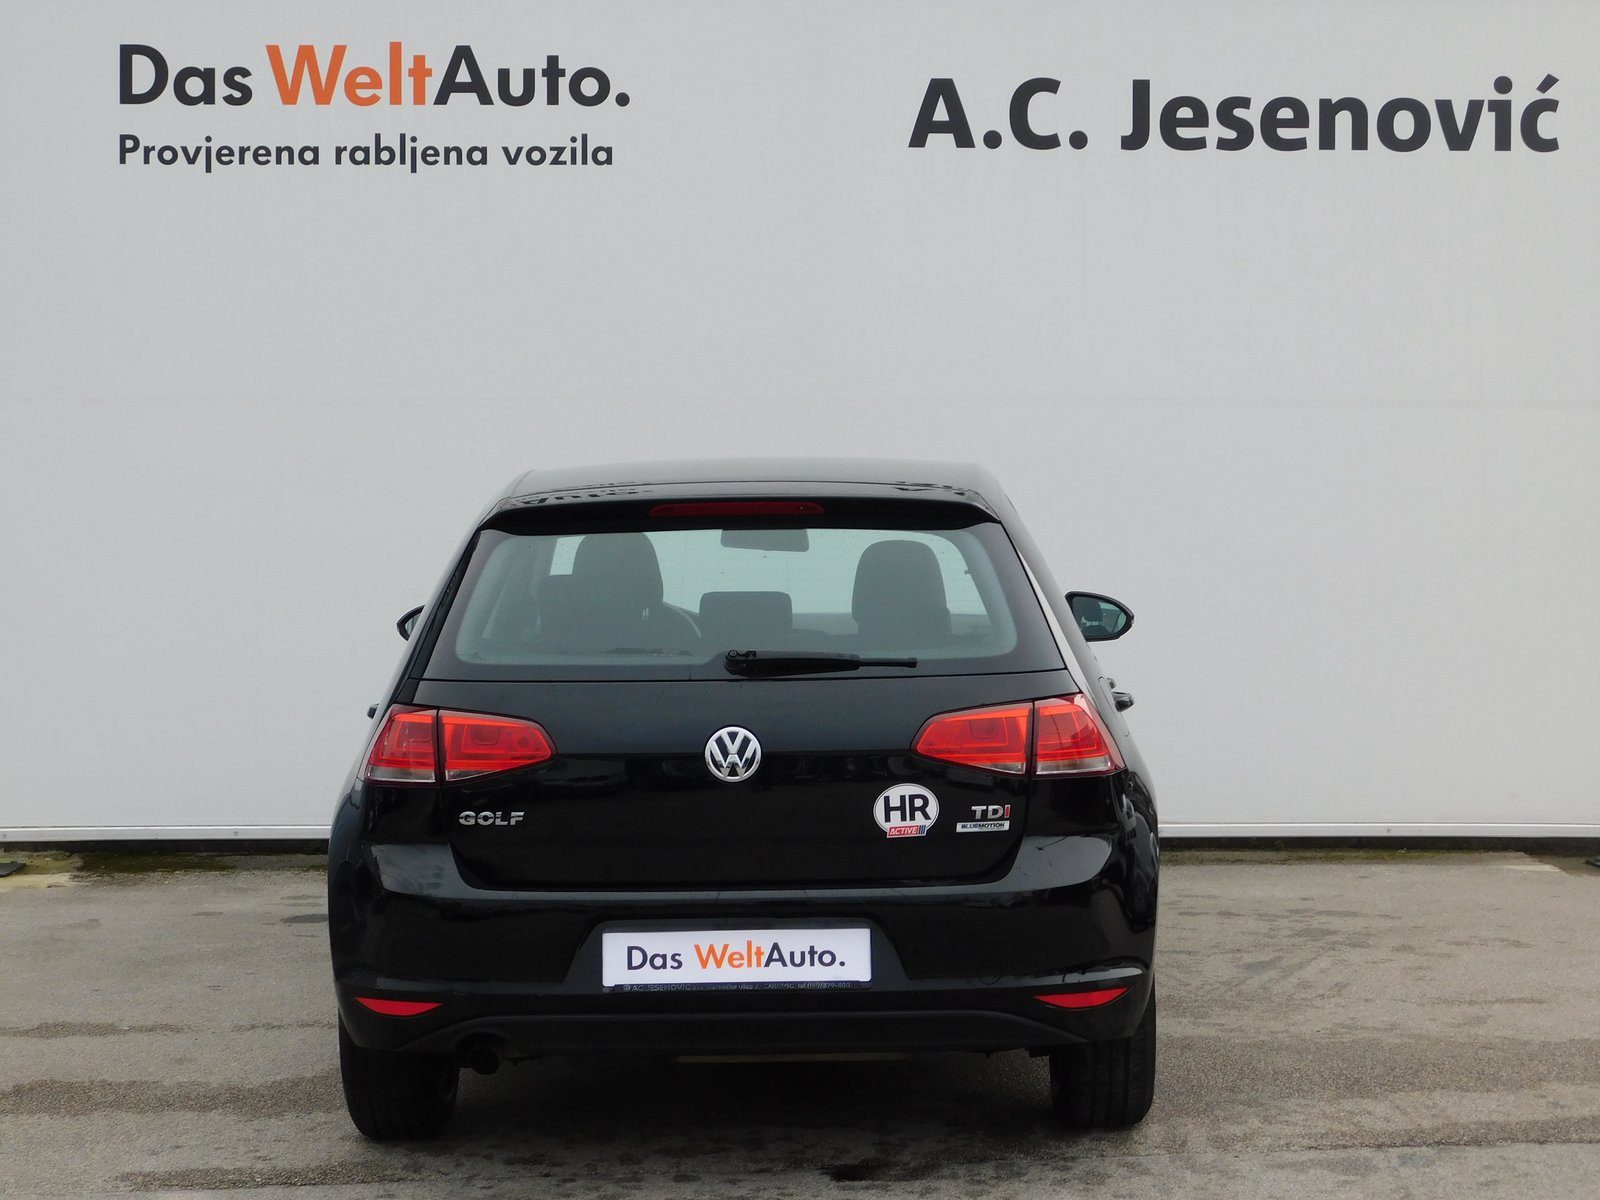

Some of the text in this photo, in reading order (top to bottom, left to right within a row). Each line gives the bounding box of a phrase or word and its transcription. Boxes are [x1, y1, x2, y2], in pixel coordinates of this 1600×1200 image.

[119, 41, 631, 108] Das WeltAuto.
[907, 73, 1561, 153] A.C. Jesenović
[119, 132, 614, 174] Provjerena rabljena vozila
[458, 811, 526, 826] GOLF
[883, 793, 932, 823] HR
[970, 804, 1011, 820] TDI
[888, 825, 919, 837] ACTIVE
[626, 940, 847, 972] Das WeltAuto.
